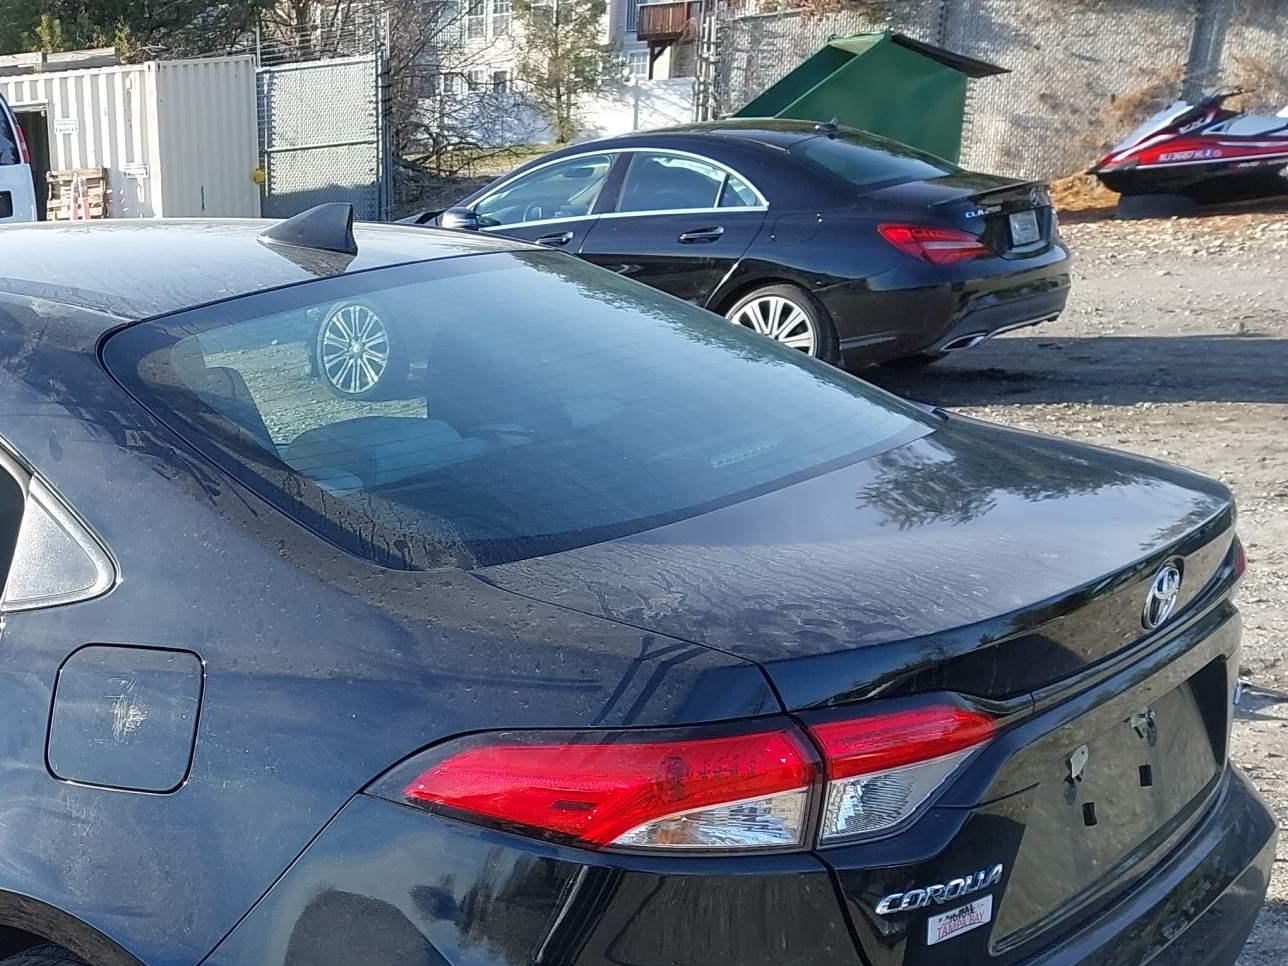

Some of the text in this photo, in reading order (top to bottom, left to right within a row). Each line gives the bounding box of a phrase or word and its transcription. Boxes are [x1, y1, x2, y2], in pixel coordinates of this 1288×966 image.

[875, 863, 1003, 915] COROLLA
[936, 910, 985, 940] TAMPA BAY
